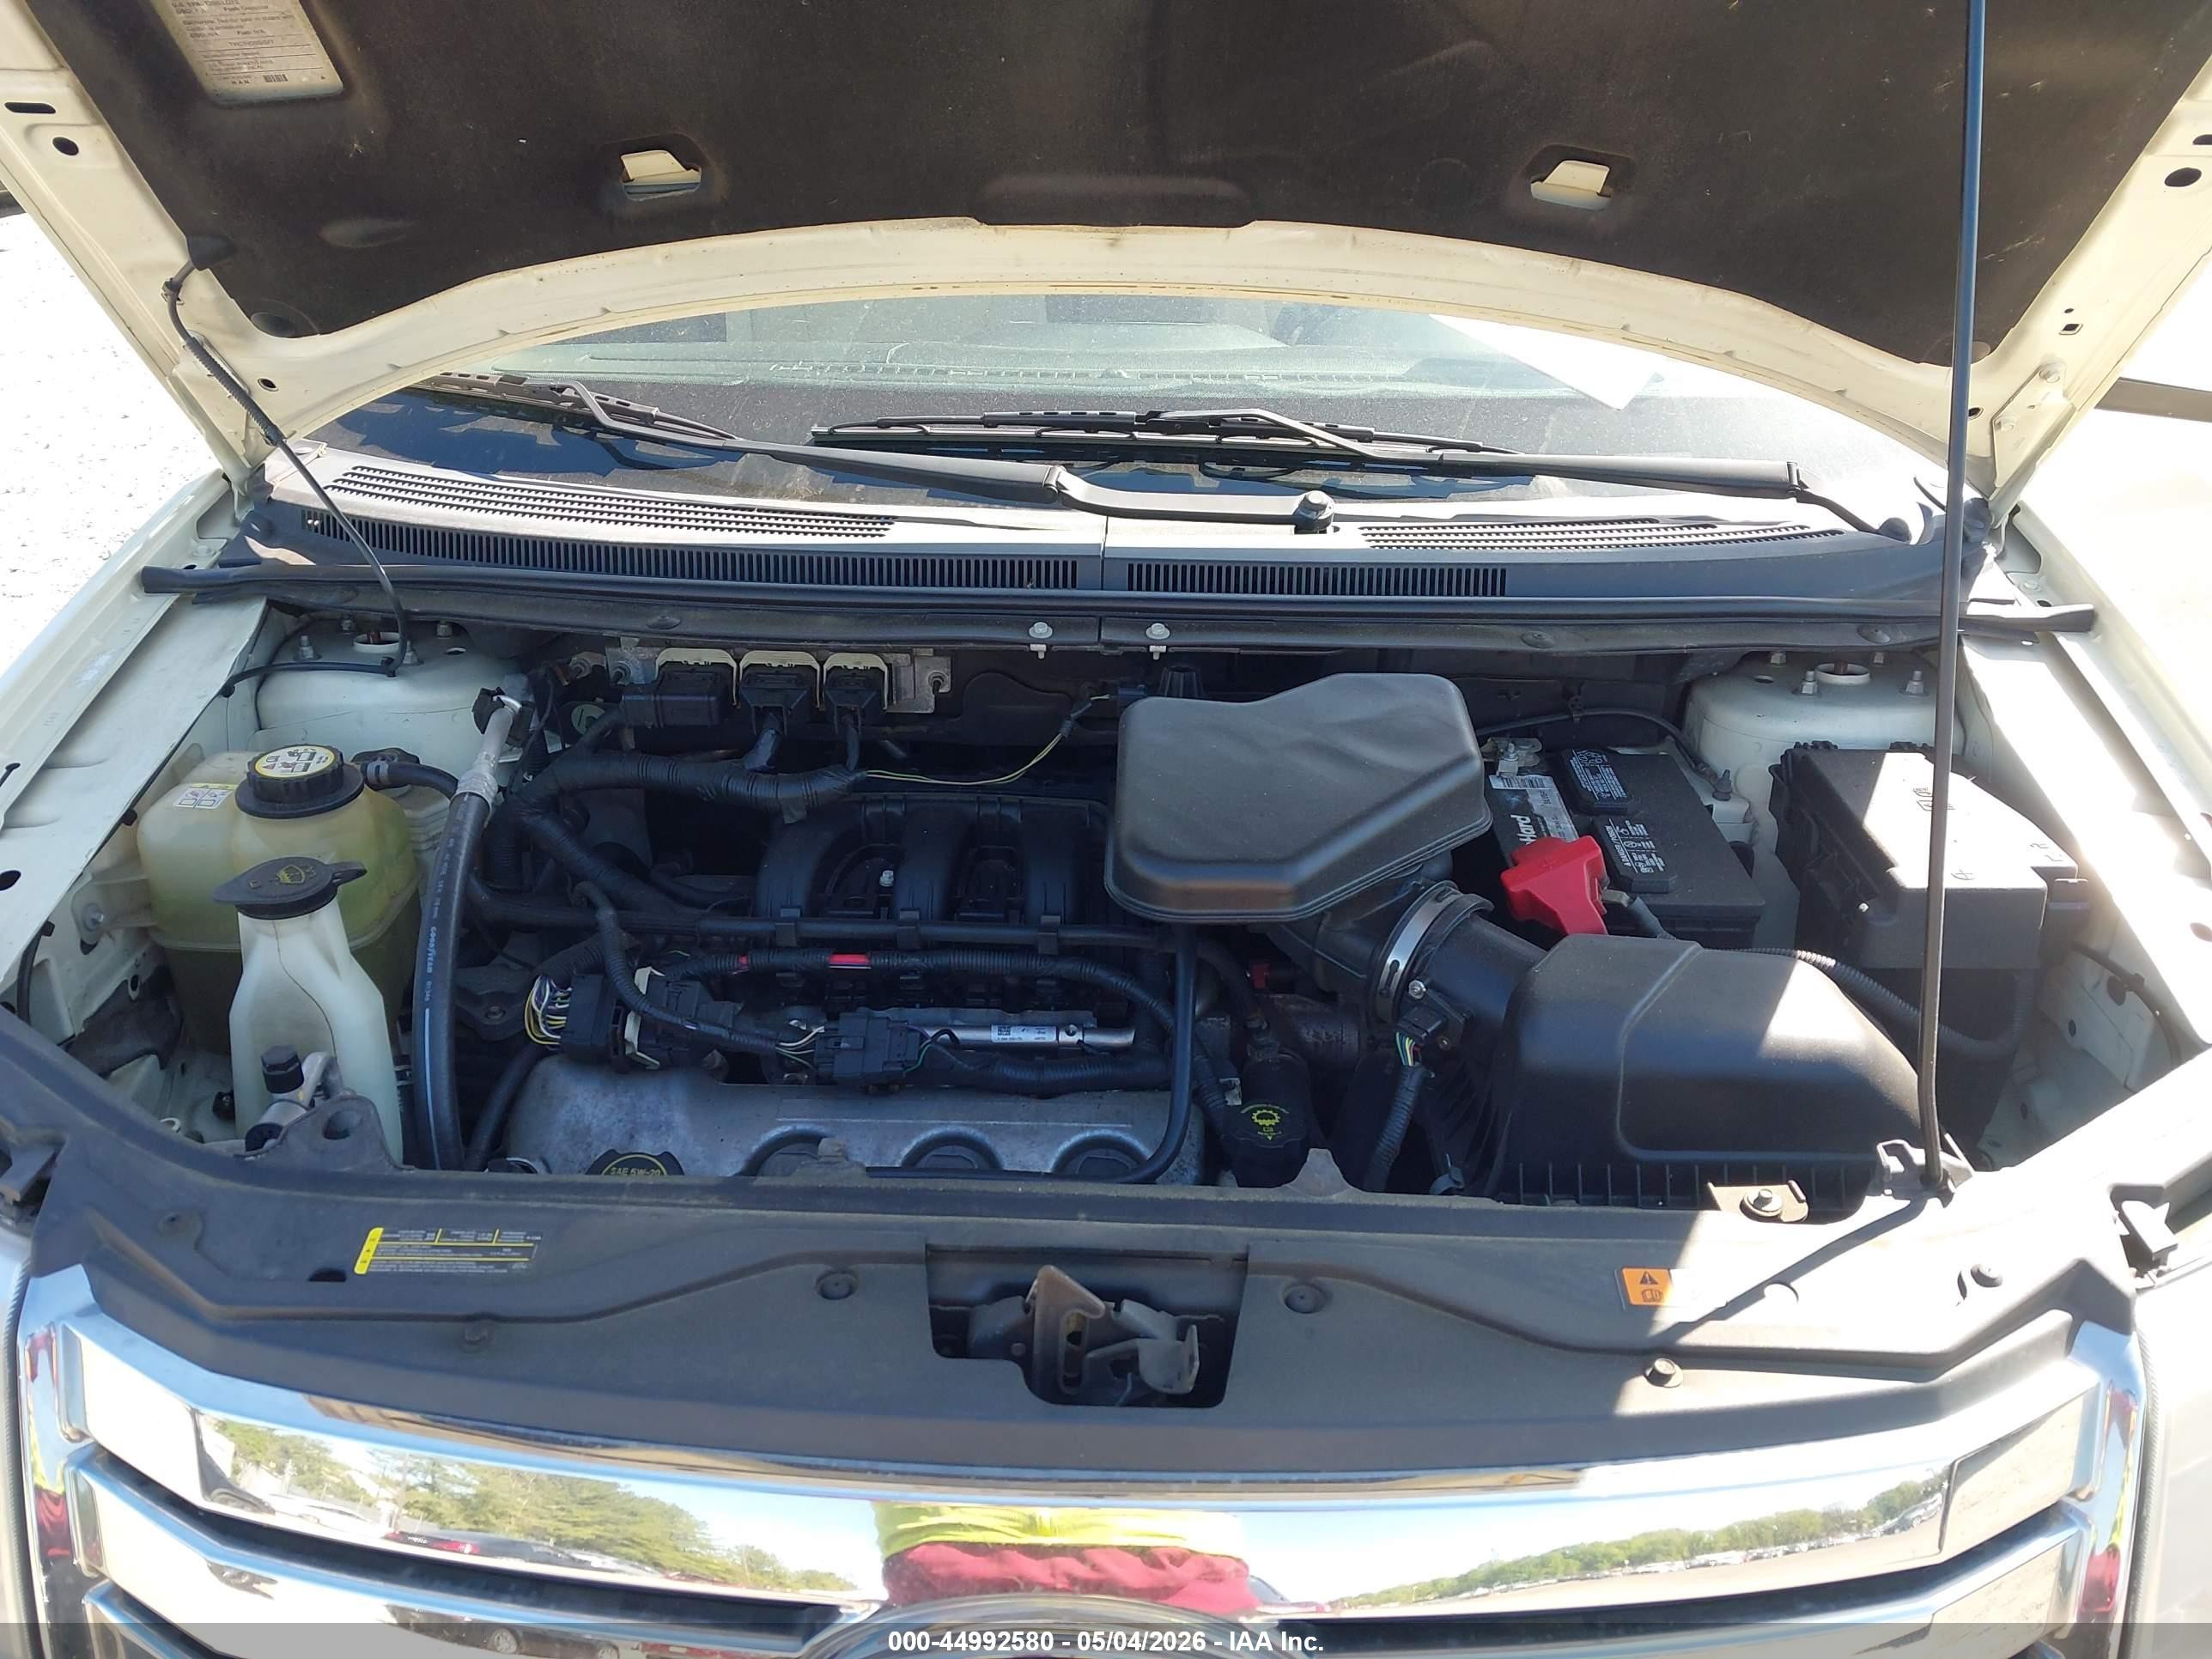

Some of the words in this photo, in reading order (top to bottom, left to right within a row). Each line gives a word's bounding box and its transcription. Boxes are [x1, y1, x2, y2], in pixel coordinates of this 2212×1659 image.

[1510, 814, 1538, 845] Hard
[426, 927, 437, 973] GOODYEAR
[611, 1167, 629, 1176] SAE
